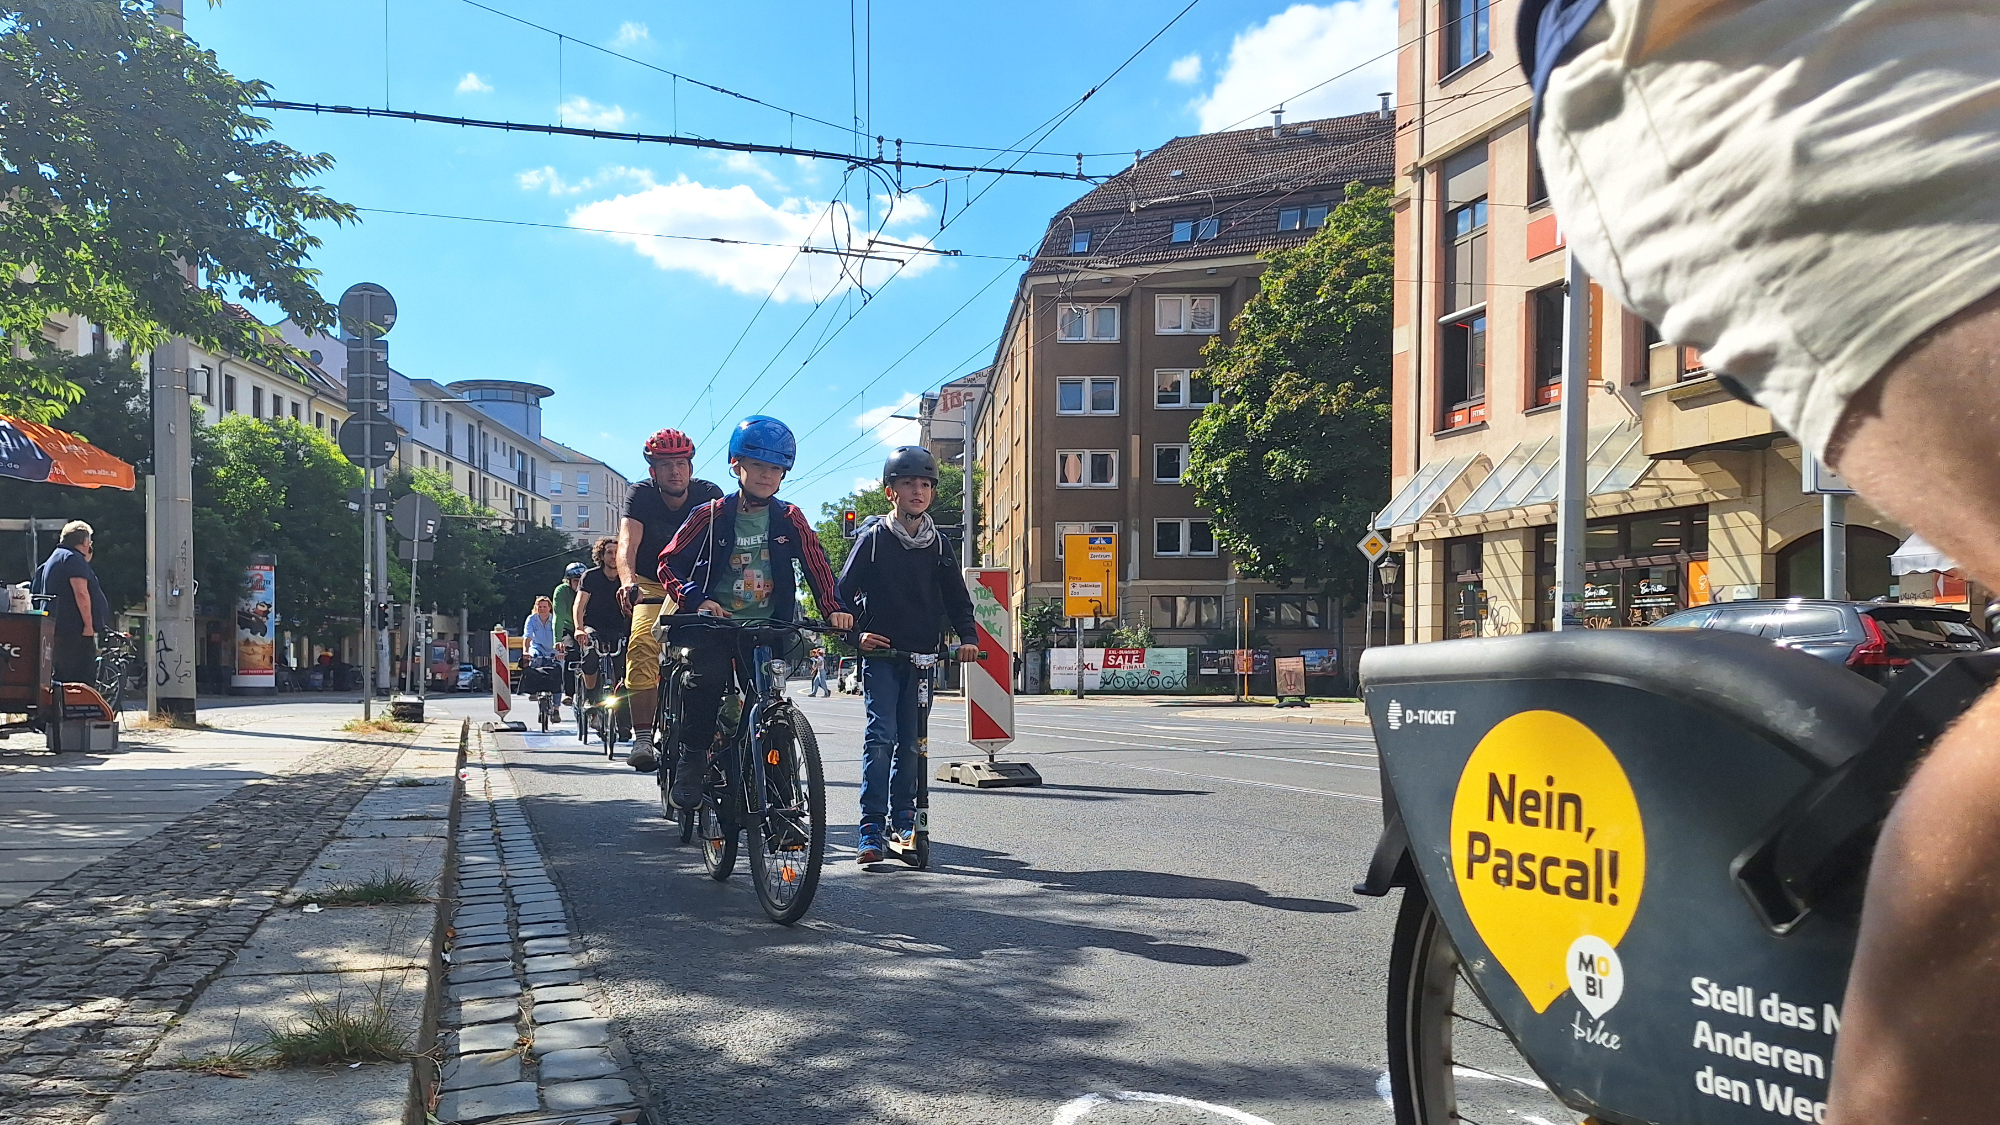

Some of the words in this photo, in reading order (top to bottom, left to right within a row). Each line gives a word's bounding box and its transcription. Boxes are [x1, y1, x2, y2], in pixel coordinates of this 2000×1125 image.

[1107, 655, 1140, 665] SALE
[1405, 709, 1457, 726] D-TICKET
[1486, 772, 1597, 844] Nein,
[1466, 830, 1620, 907] Pascal!
[1690, 975, 1755, 1018] Stell
[1758, 992, 1818, 1032] das
[1692, 1019, 1826, 1080] Anderen
[1694, 1064, 1752, 1106] den
